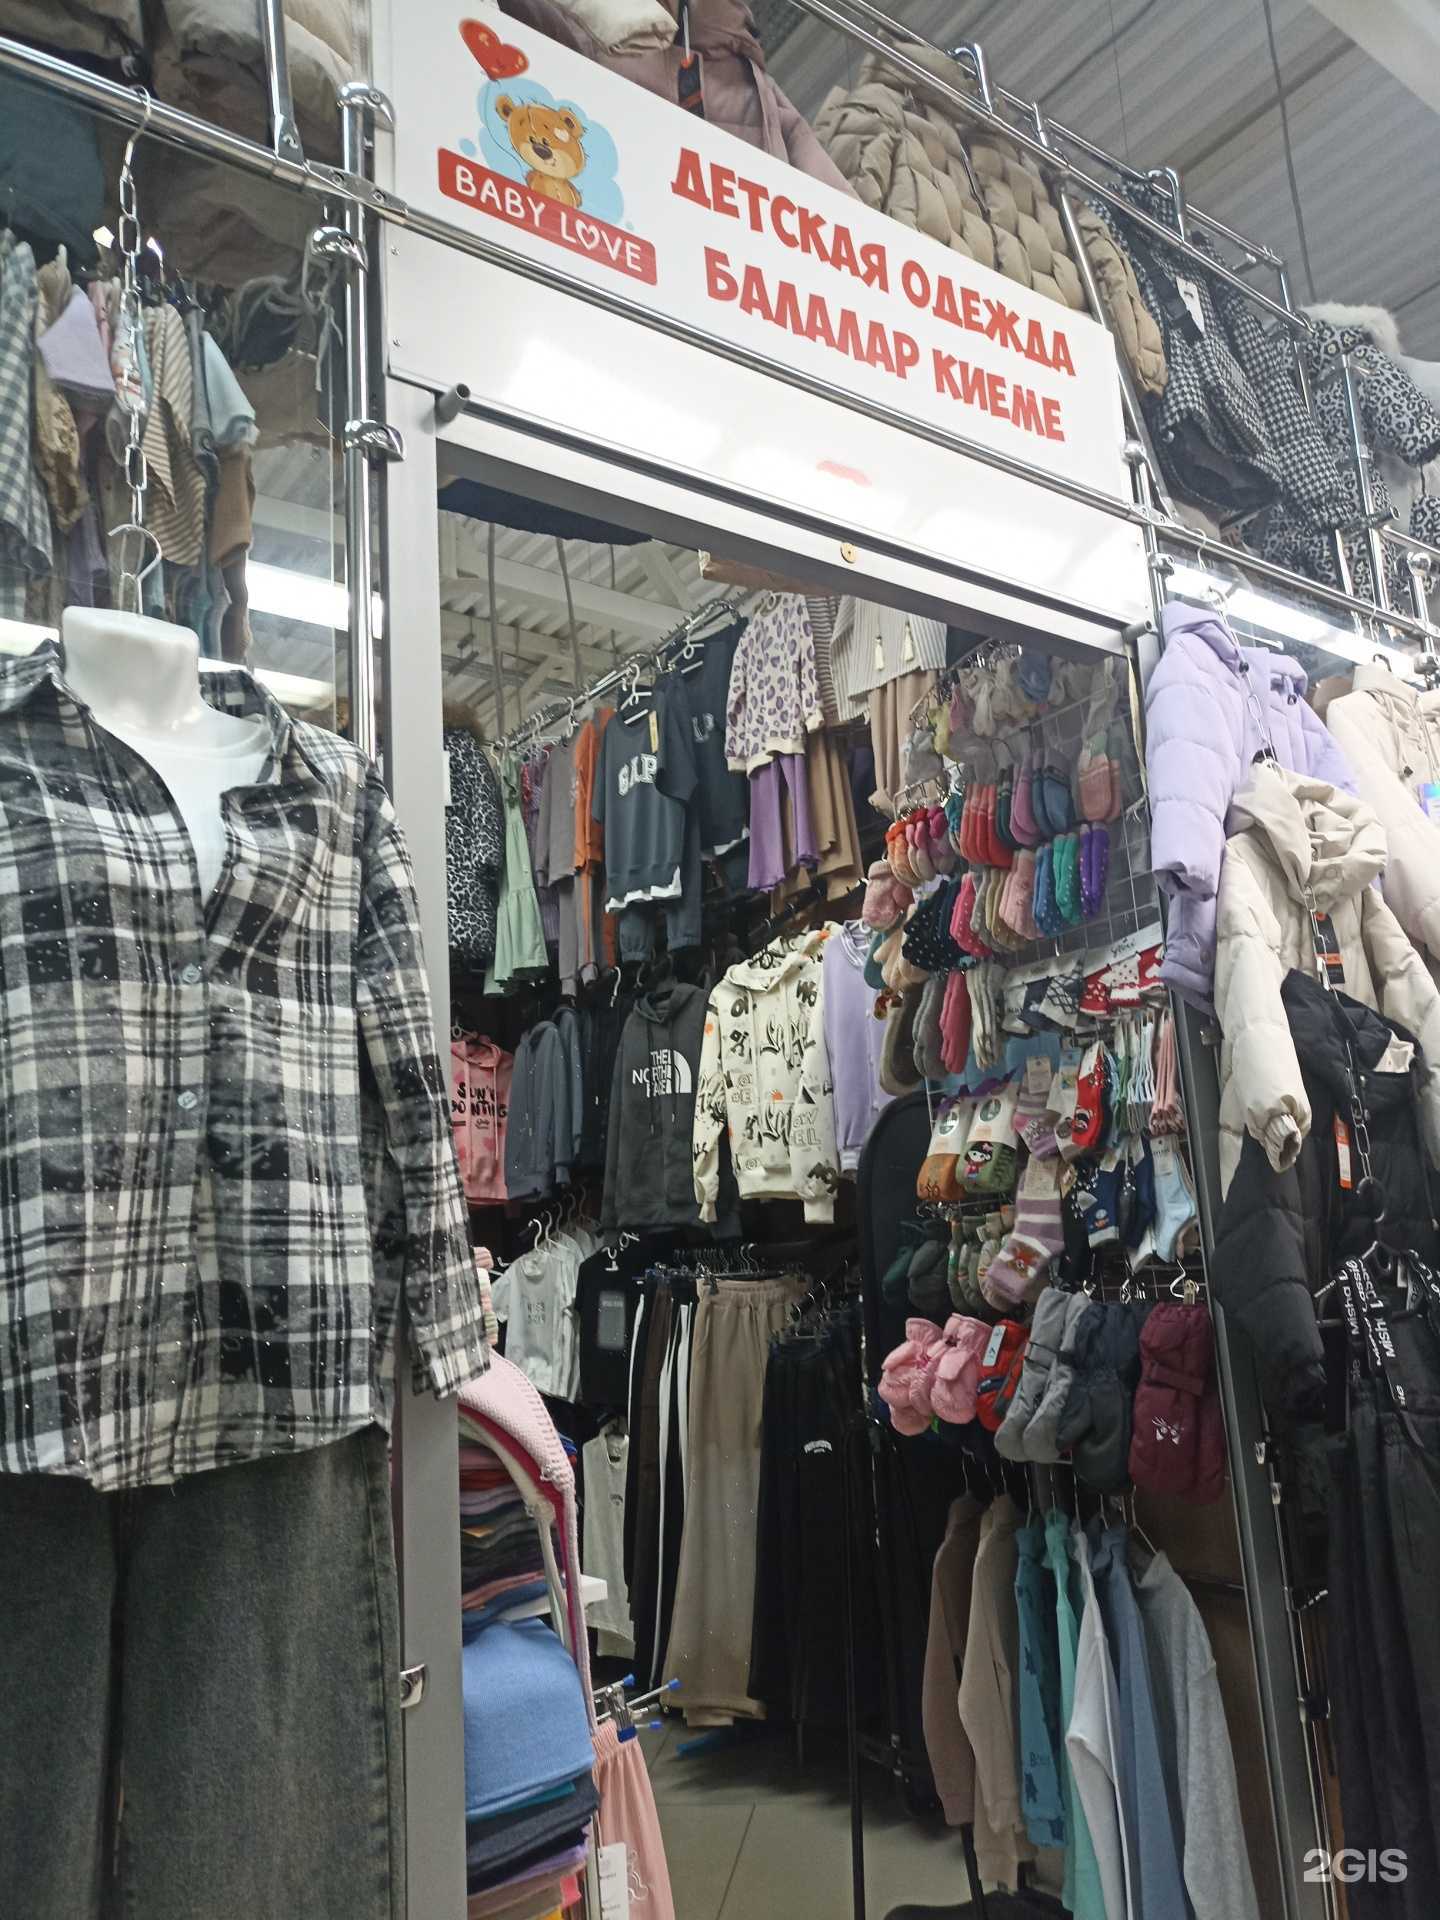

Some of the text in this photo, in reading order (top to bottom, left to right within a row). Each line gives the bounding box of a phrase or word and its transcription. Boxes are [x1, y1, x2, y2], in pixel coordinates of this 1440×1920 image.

[455, 164, 545, 227] BABY
[671, 147, 1076, 376] ДЕТСКАЯ ОДЕЖДА
[703, 245, 1065, 442] БАЛАЛАР КИЕМЕ
